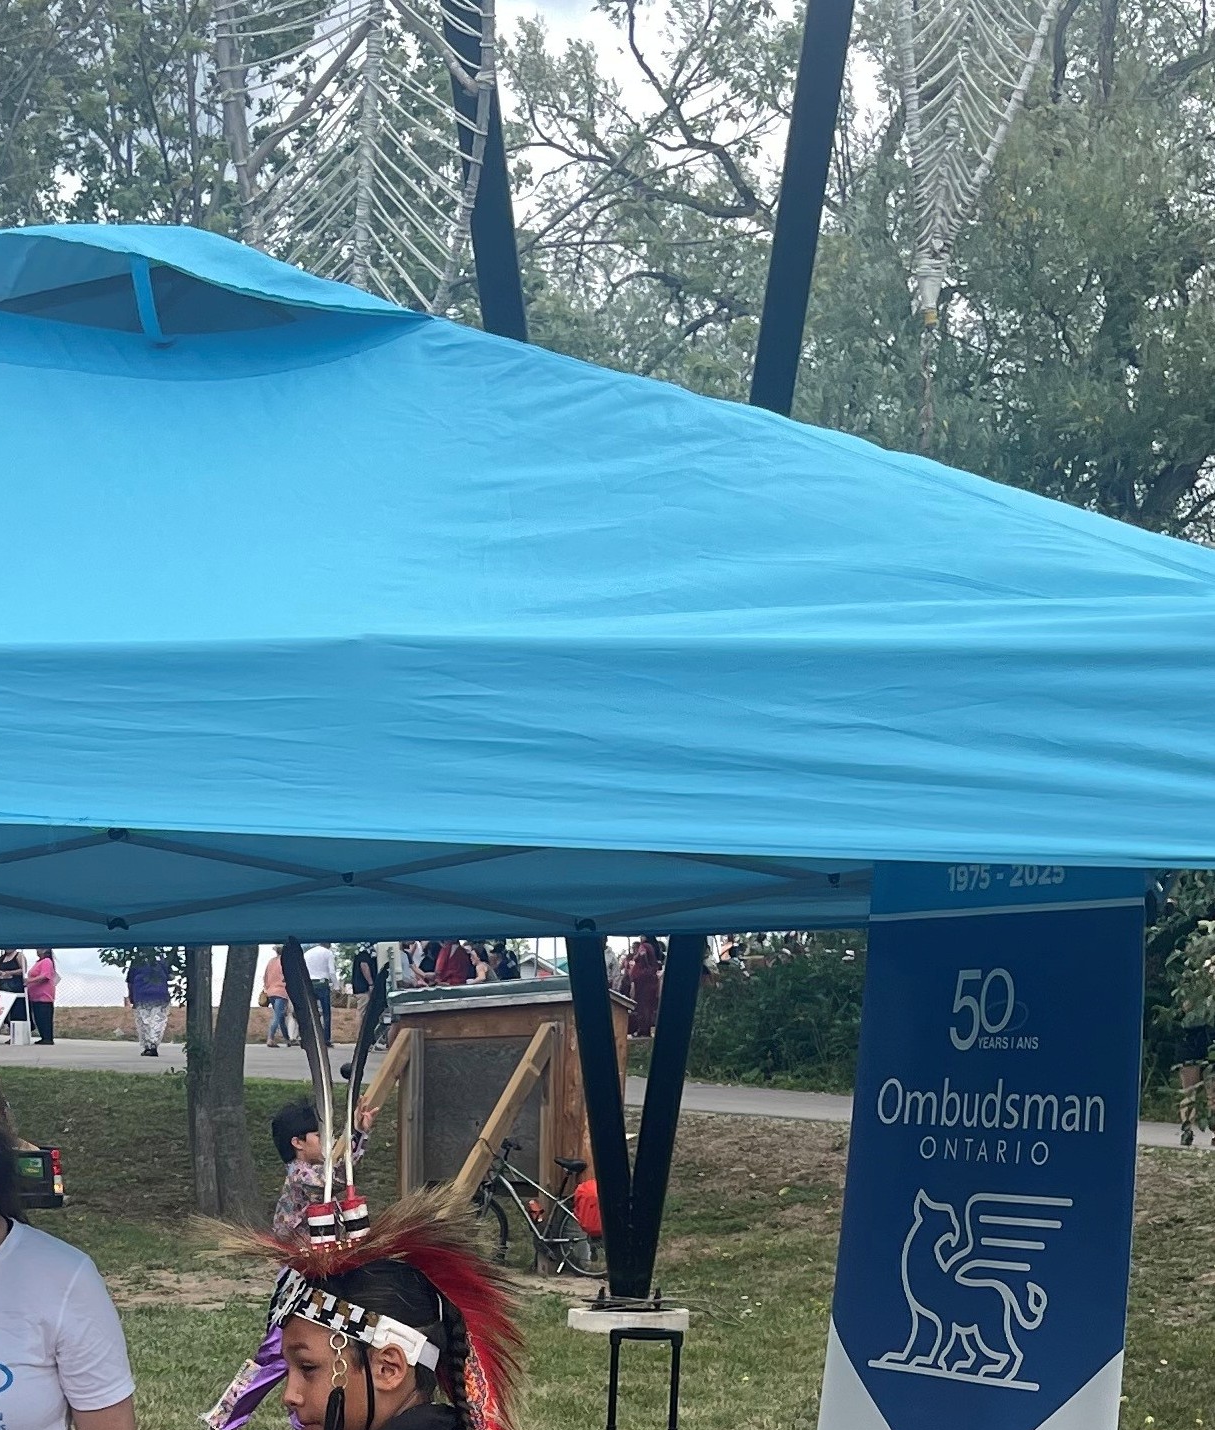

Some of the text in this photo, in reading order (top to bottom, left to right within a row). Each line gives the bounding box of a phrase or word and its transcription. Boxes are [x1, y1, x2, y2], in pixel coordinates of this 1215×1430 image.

[947, 864, 991, 892] 1975
[949, 967, 1015, 1051] 50
[977, 1036, 1009, 1050] YEARS
[1016, 1036, 1039, 1050] ANS
[877, 1077, 1106, 1133] Ombudsman
[919, 1135, 1049, 1166] ONTARIO
